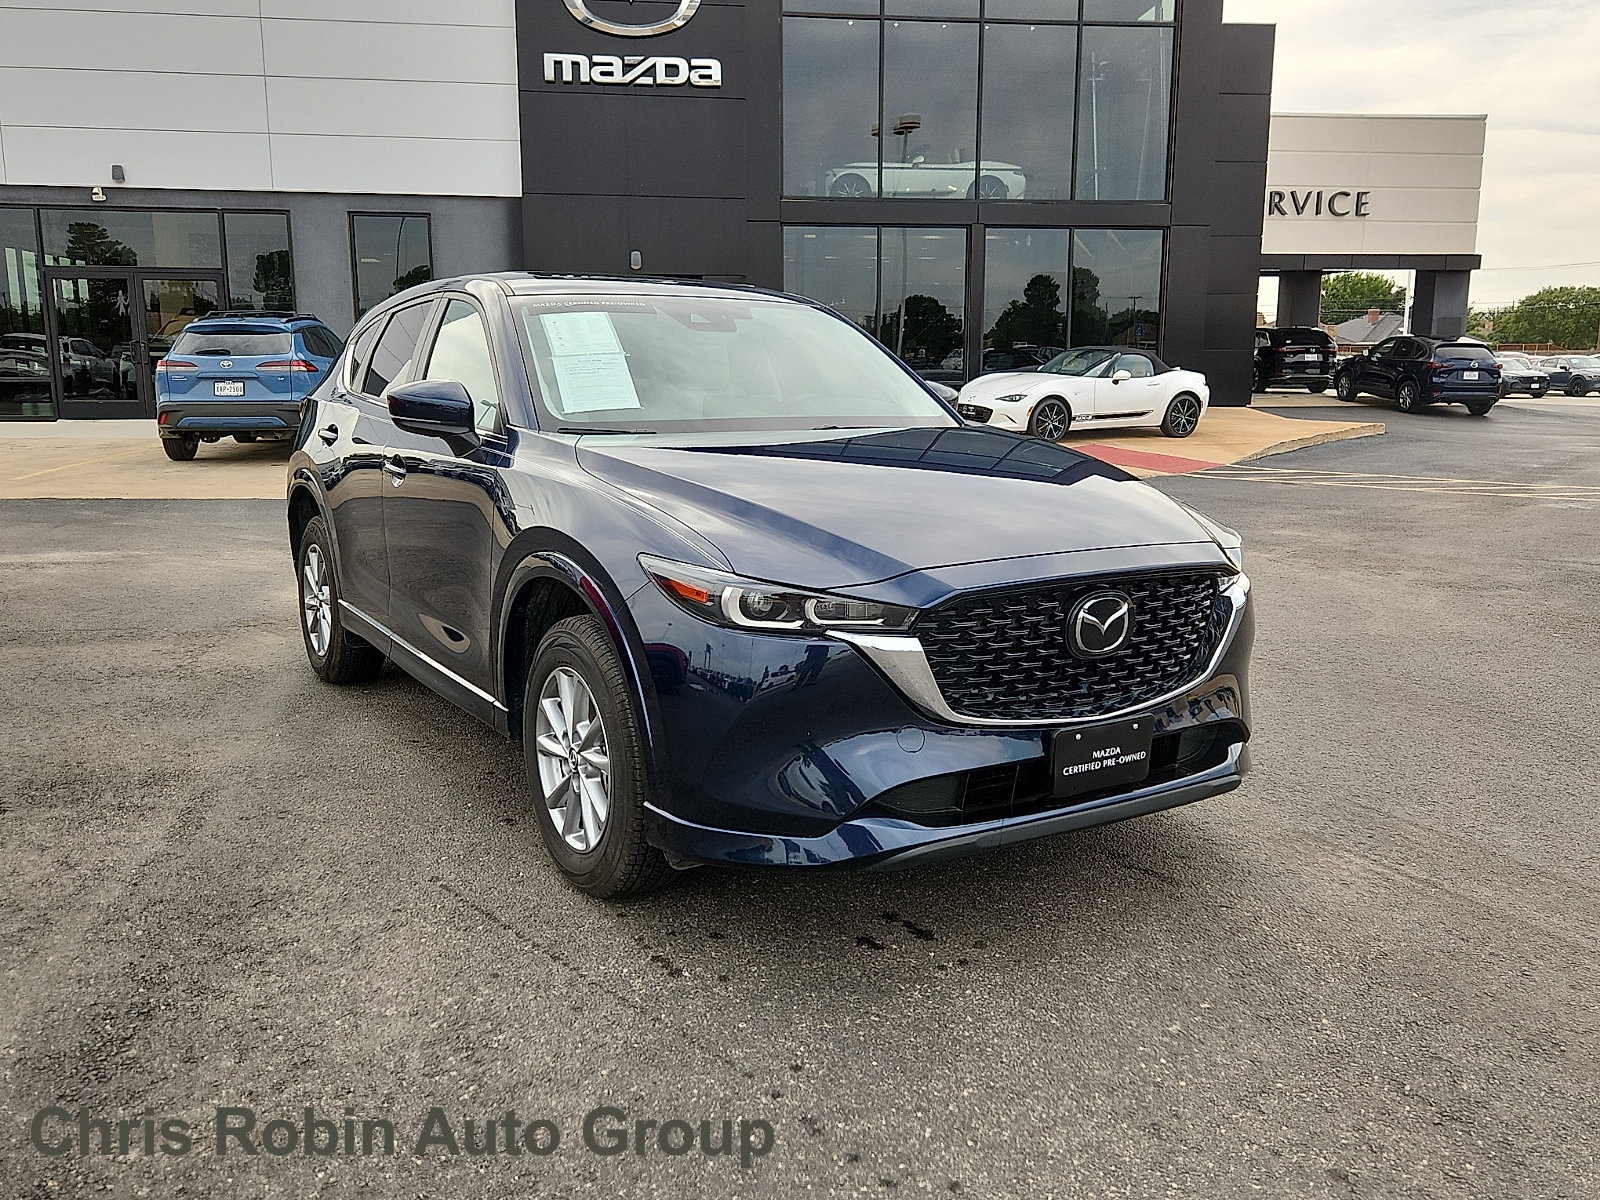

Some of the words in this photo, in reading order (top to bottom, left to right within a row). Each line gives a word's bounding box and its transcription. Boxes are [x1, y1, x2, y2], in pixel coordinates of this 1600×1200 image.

[1092, 746, 1122, 760] MAZDA
[1062, 761, 1102, 776] CERTIFIED
[1102, 751, 1147, 769] PRE-OWNED
